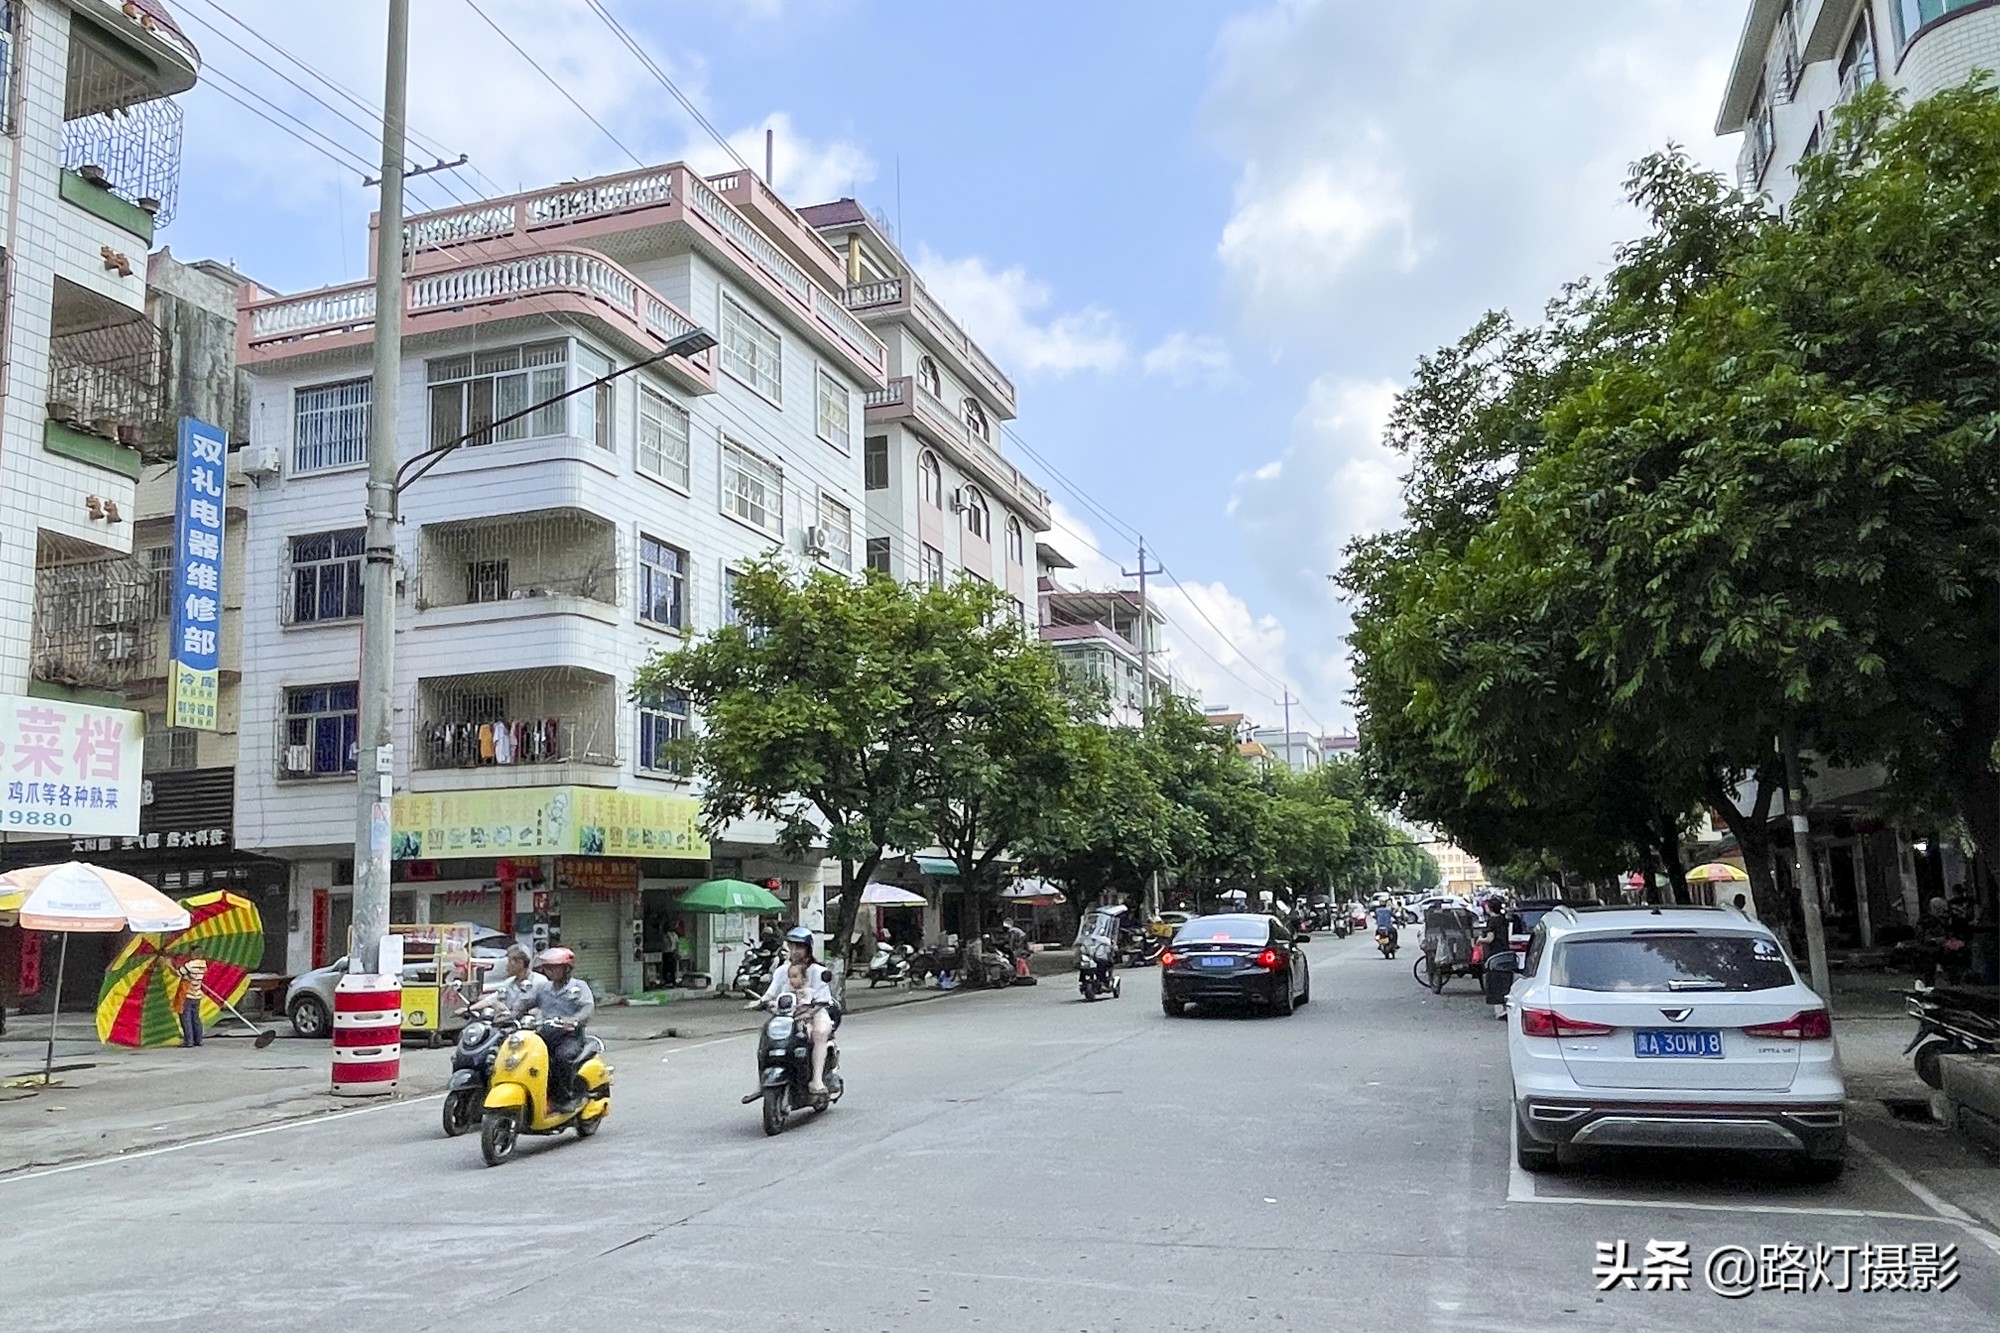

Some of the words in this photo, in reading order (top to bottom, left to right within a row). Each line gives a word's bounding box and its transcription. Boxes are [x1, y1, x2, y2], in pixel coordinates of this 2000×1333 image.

[184, 433, 222, 655] 双礼电器维修部
[0, 706, 123, 780] 菜档
[8, 780, 119, 809] 鸡爪等各种熟菜
